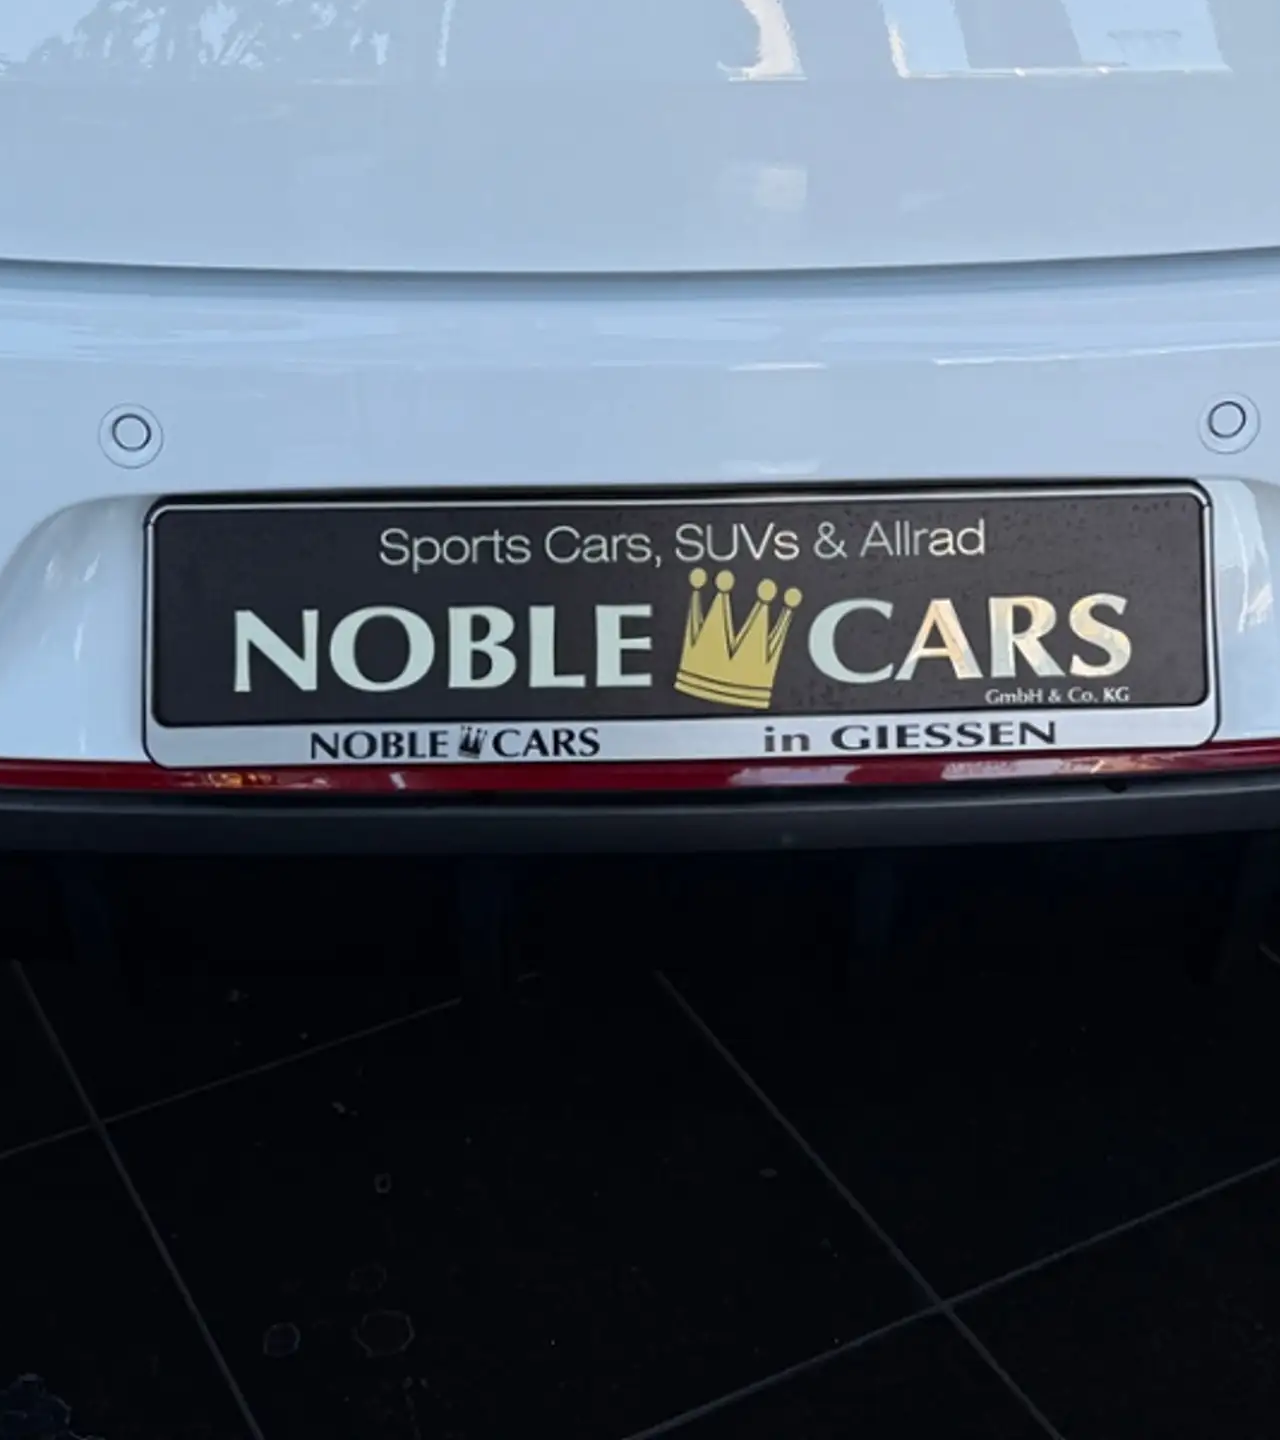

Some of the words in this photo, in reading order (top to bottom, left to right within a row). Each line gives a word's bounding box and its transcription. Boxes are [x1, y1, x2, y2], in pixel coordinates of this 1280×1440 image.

[379, 527, 532, 574] Sports
[543, 525, 662, 568] Cars,
[675, 522, 800, 562] SUVs
[813, 520, 848, 560] &
[859, 518, 987, 558] Allrad
[232, 603, 653, 693] NOBLE
[807, 592, 1133, 685] CARS
[984, 687, 1044, 705] GmbH
[1047, 687, 1062, 704] &
[1067, 686, 1099, 703] Co.
[1103, 685, 1131, 703] KG
[310, 729, 450, 760] NOBLE
[491, 727, 601, 758] CARS
[763, 725, 811, 753] in
[830, 720, 1057, 751] GIESSEN
